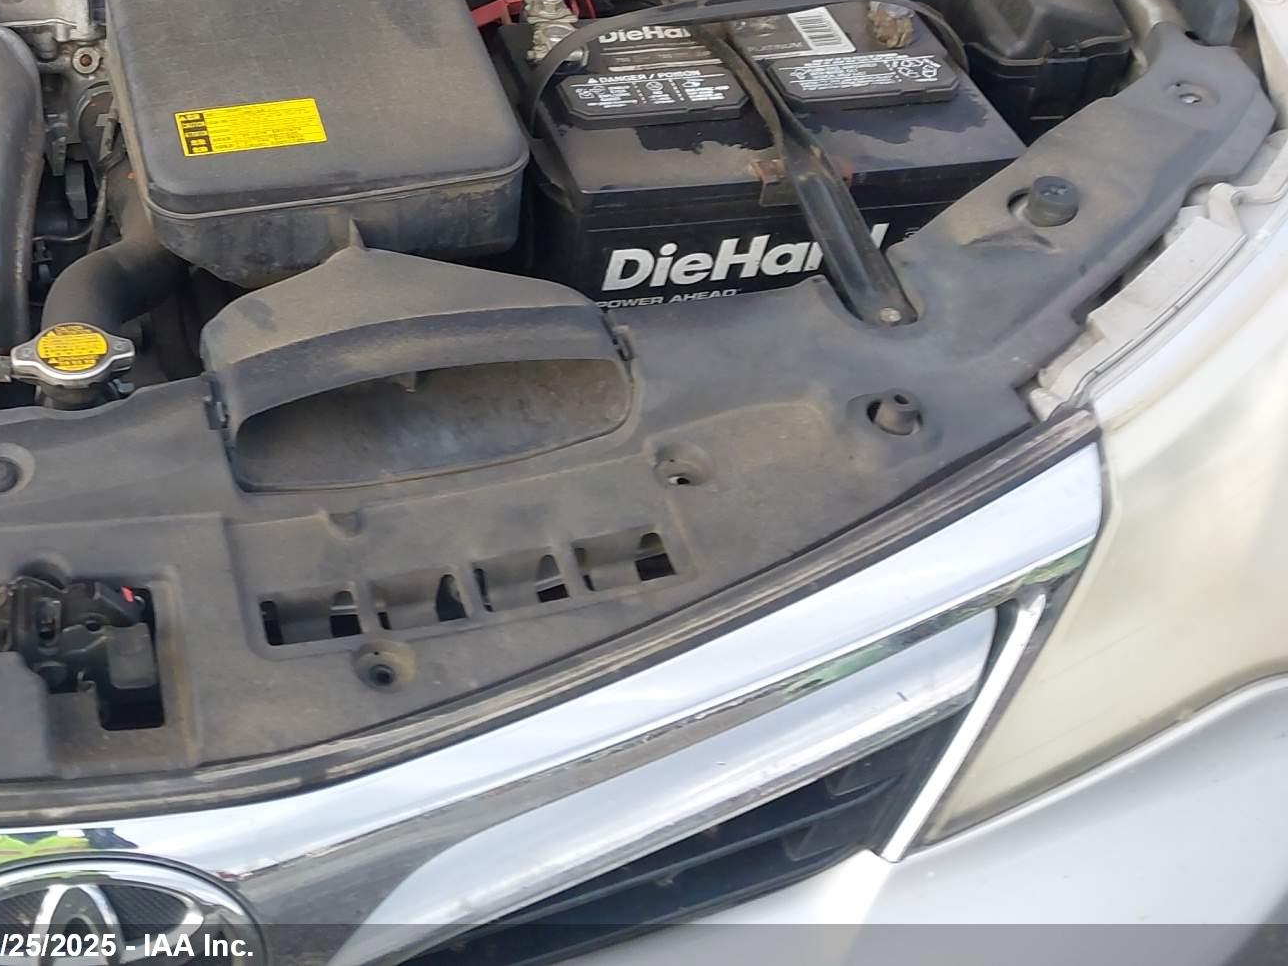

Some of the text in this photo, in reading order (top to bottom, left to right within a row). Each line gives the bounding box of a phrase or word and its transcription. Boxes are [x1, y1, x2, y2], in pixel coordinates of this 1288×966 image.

[598, 73, 647, 84] DANGER
[595, 289, 737, 308] POWER AHEAD
